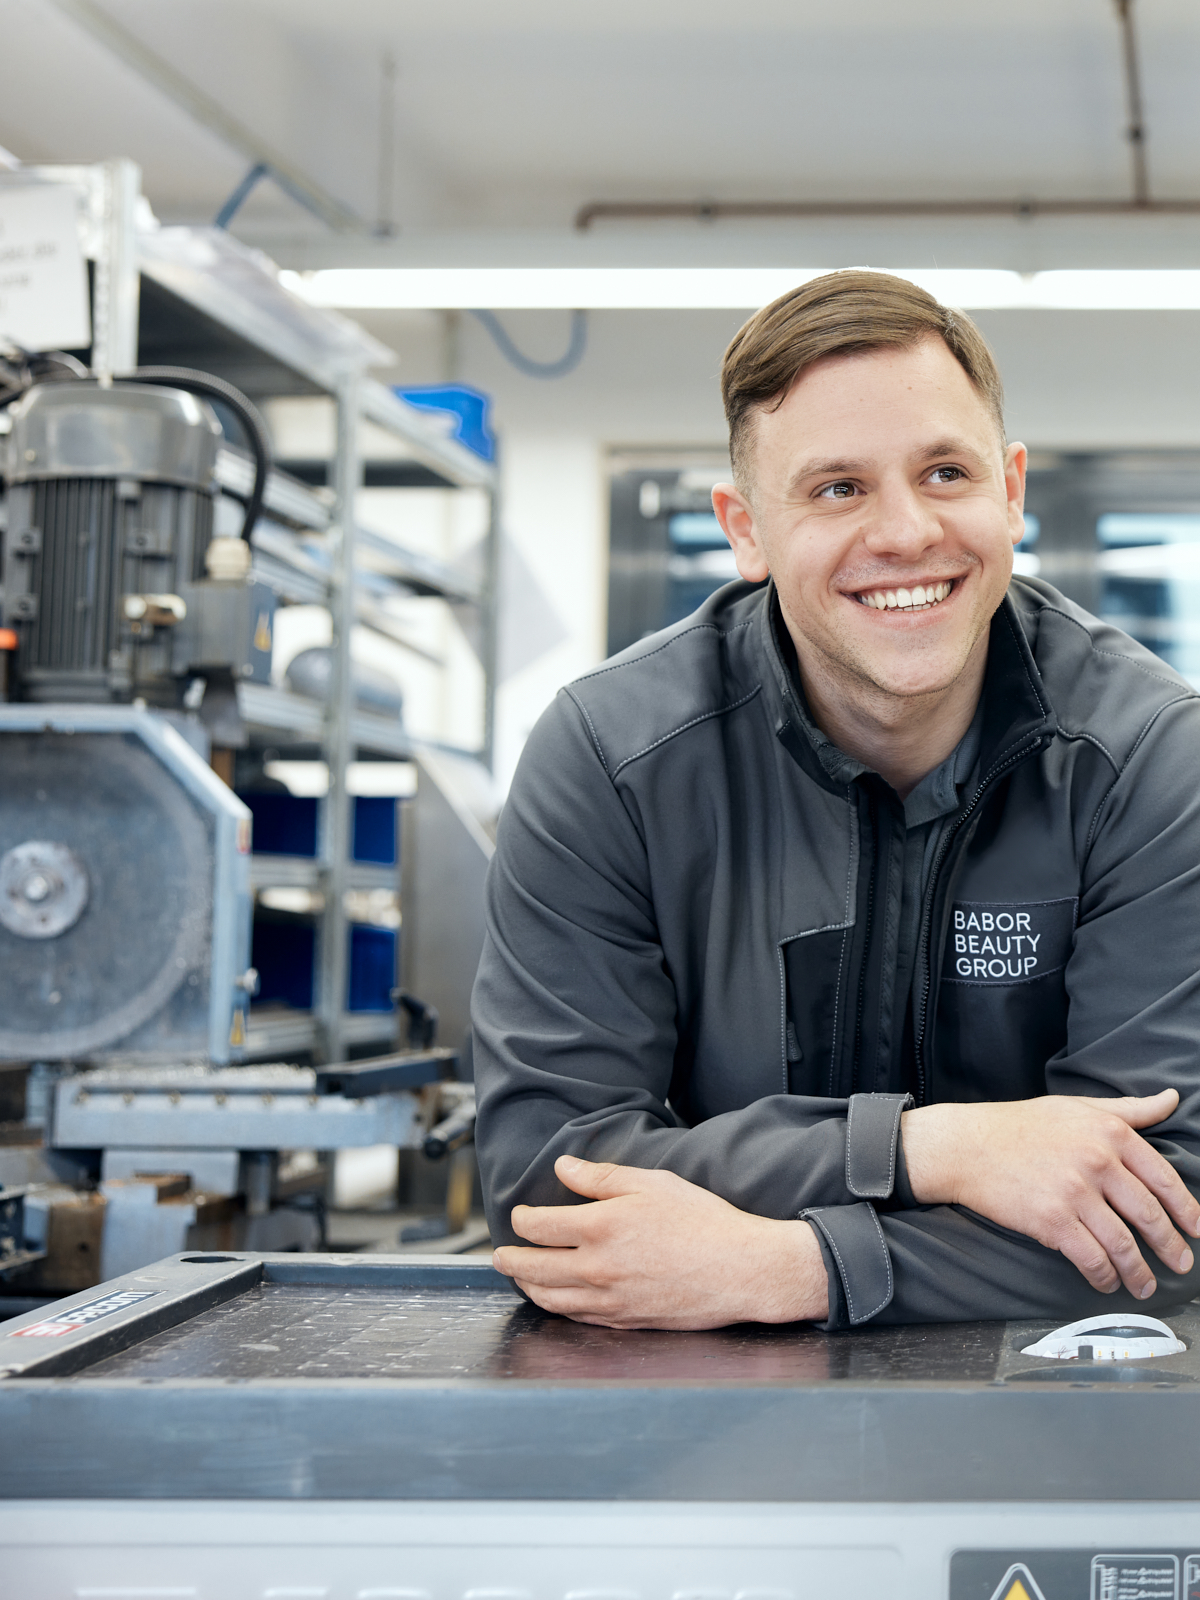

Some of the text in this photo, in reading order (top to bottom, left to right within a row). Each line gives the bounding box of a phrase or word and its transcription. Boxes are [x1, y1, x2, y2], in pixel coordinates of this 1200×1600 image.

[954, 910, 1031, 932] BABOR
[955, 933, 1041, 955] BEAUTY
[956, 956, 1038, 978] GROUP
